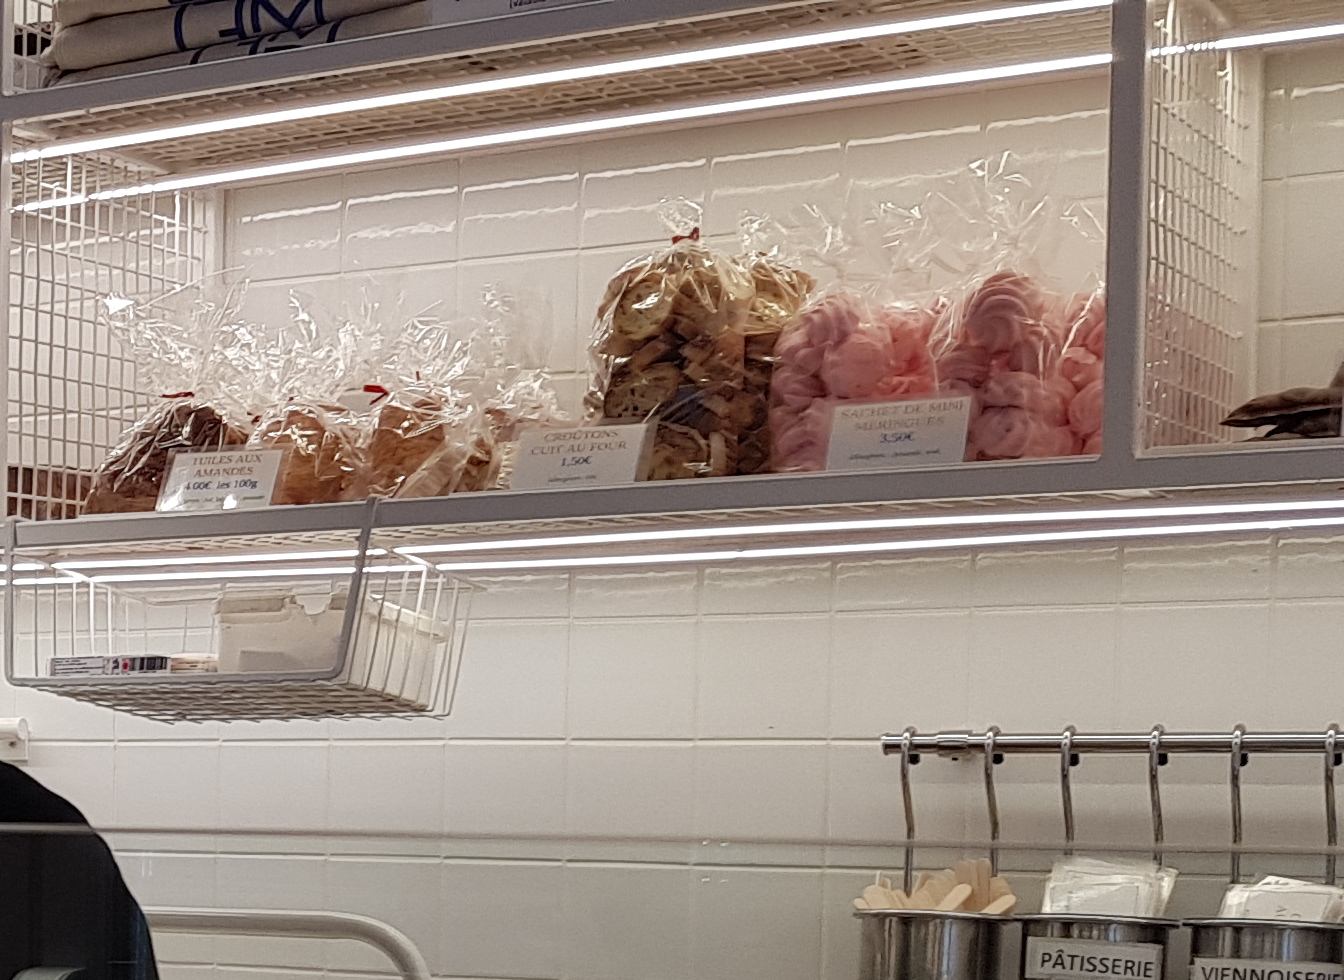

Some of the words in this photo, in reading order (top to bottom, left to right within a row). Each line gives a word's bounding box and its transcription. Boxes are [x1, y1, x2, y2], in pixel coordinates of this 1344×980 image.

[531, 444, 565, 456] CUIT
[567, 443, 586, 453] AU
[589, 440, 627, 452] FOUR
[192, 454, 233, 466] TUILES
[234, 453, 263, 464] AUX
[193, 466, 254, 478] AMANDES
[234, 478, 258, 490] 100g
[1040, 949, 1155, 979] PÂTISSERIE
